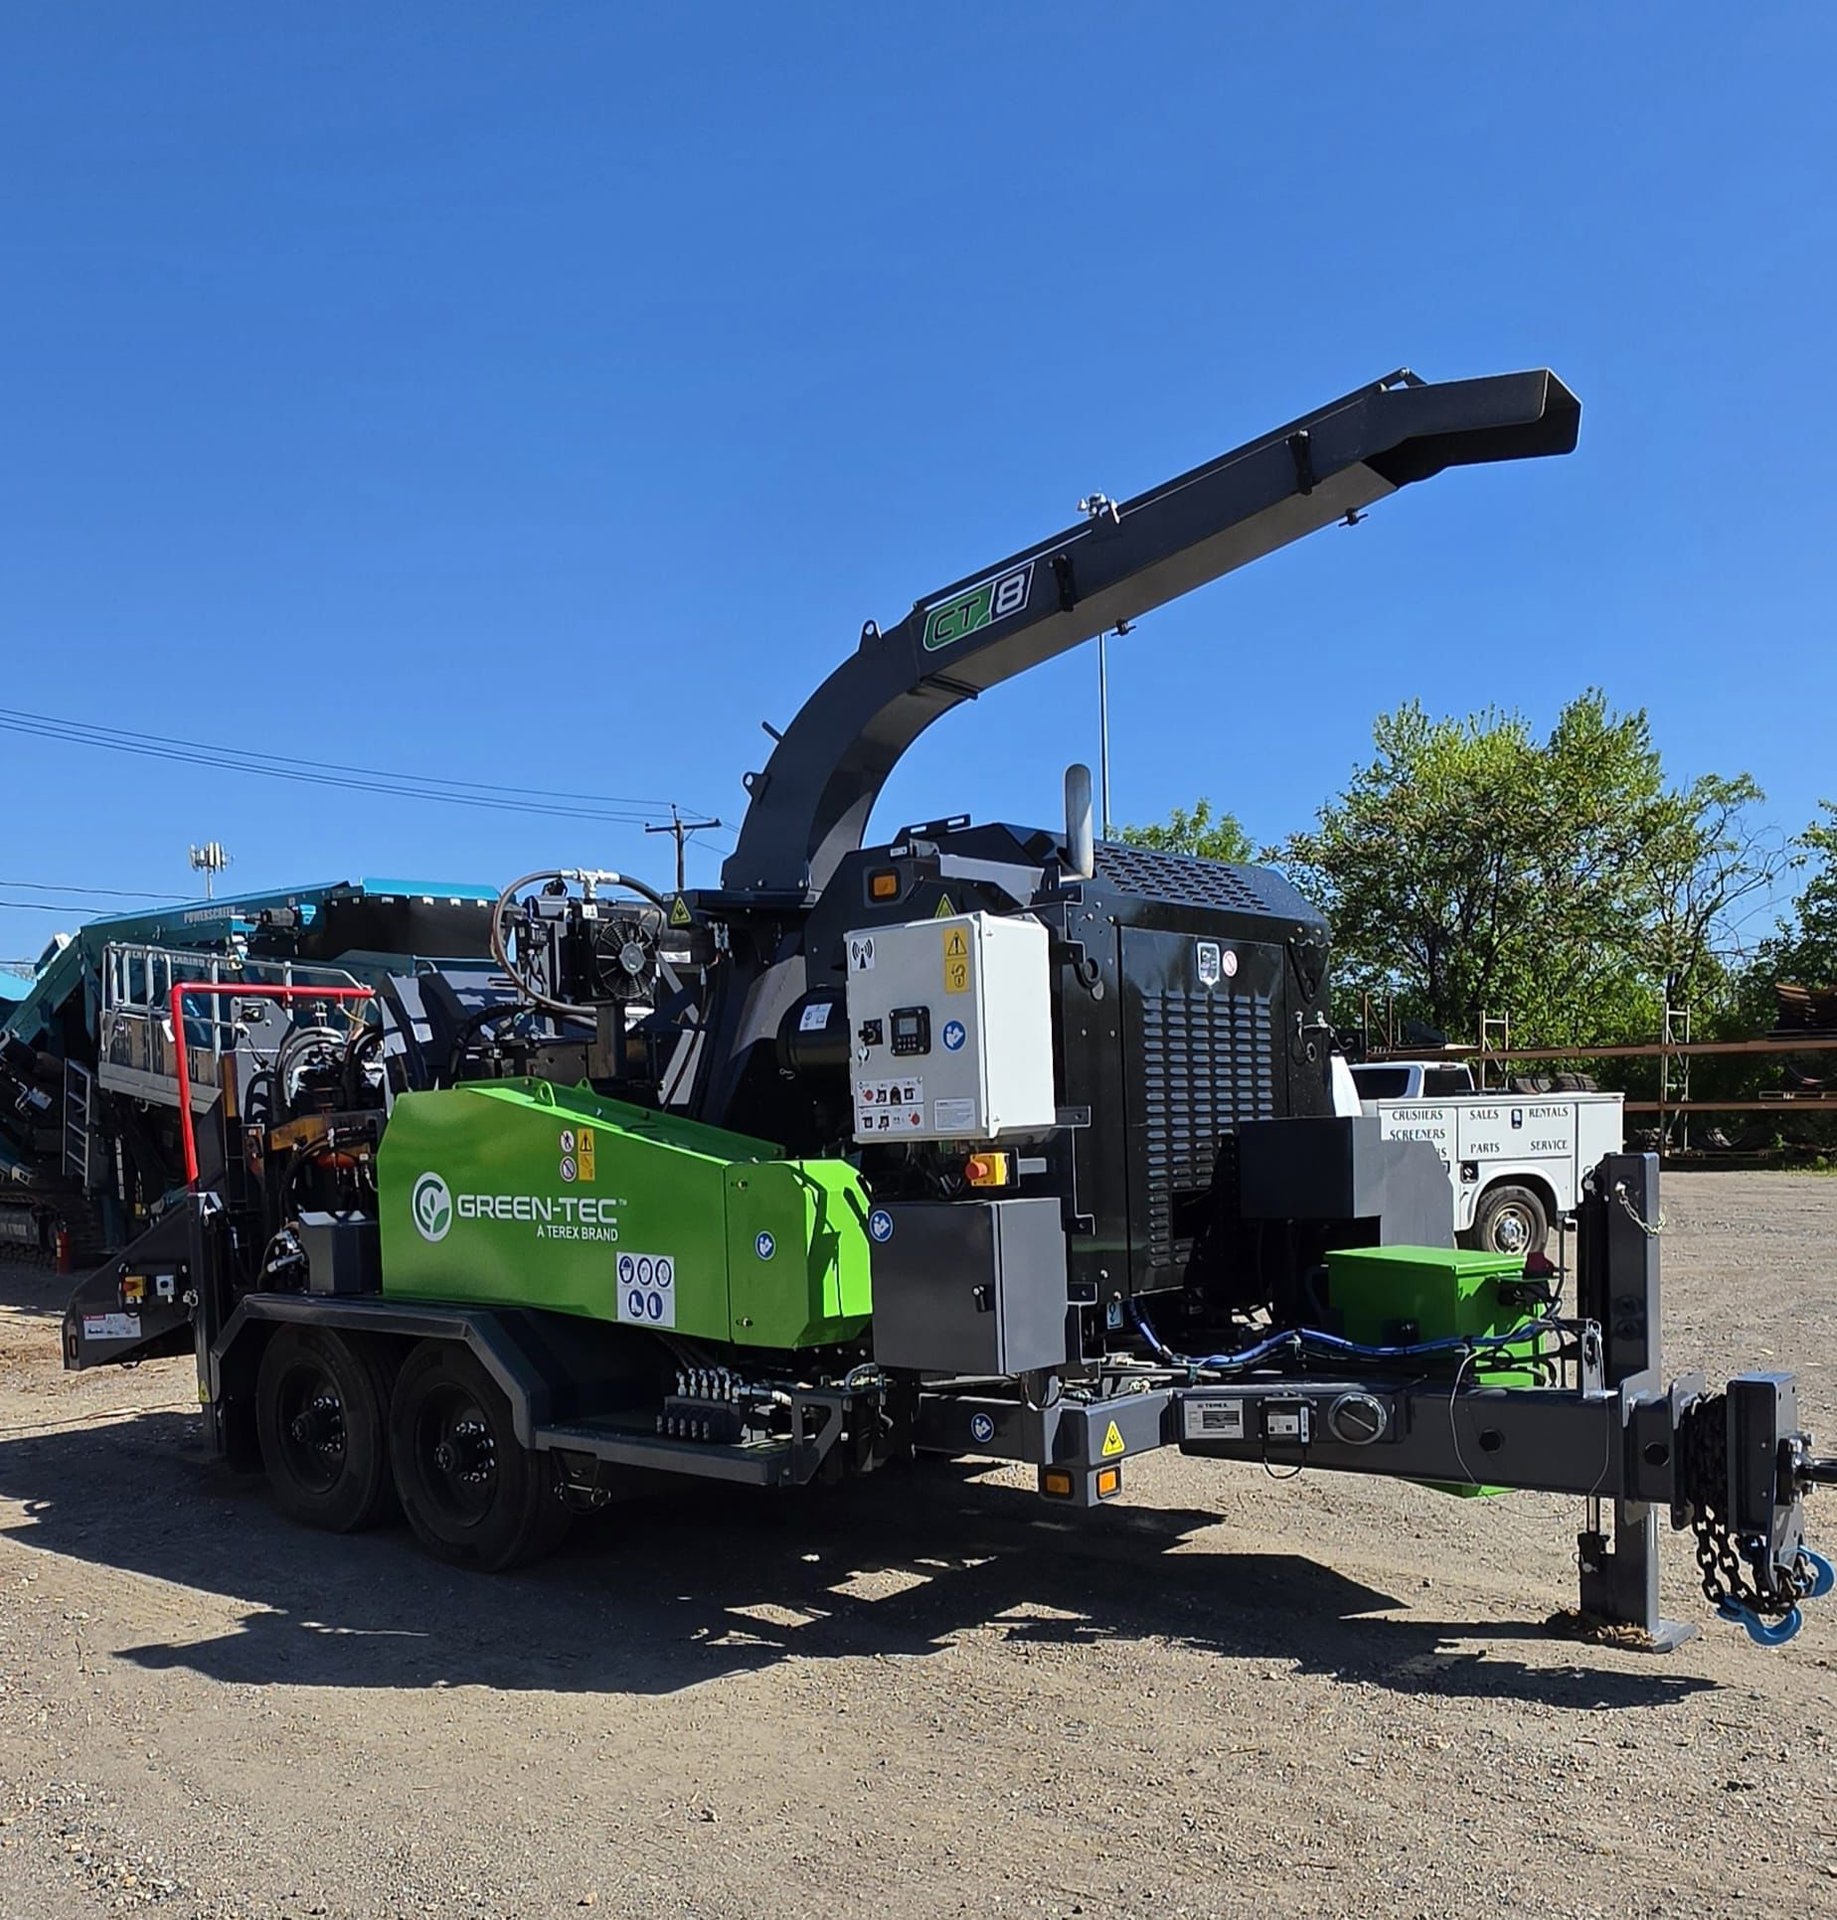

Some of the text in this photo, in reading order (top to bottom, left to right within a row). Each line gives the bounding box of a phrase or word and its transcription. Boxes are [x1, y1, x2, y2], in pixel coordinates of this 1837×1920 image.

[1392, 1109, 1444, 1121] CRUSHERS
[1469, 1108, 1499, 1121] SALES
[1528, 1106, 1569, 1119] RENTALS
[1389, 1128, 1446, 1140] SCREENERS
[1470, 1142, 1501, 1155] PARTS
[1530, 1139, 1568, 1152] SERVICE
[457, 1194, 618, 1224] GREEN-TEC
[537, 1224, 619, 1242] A TEREX BRAND
